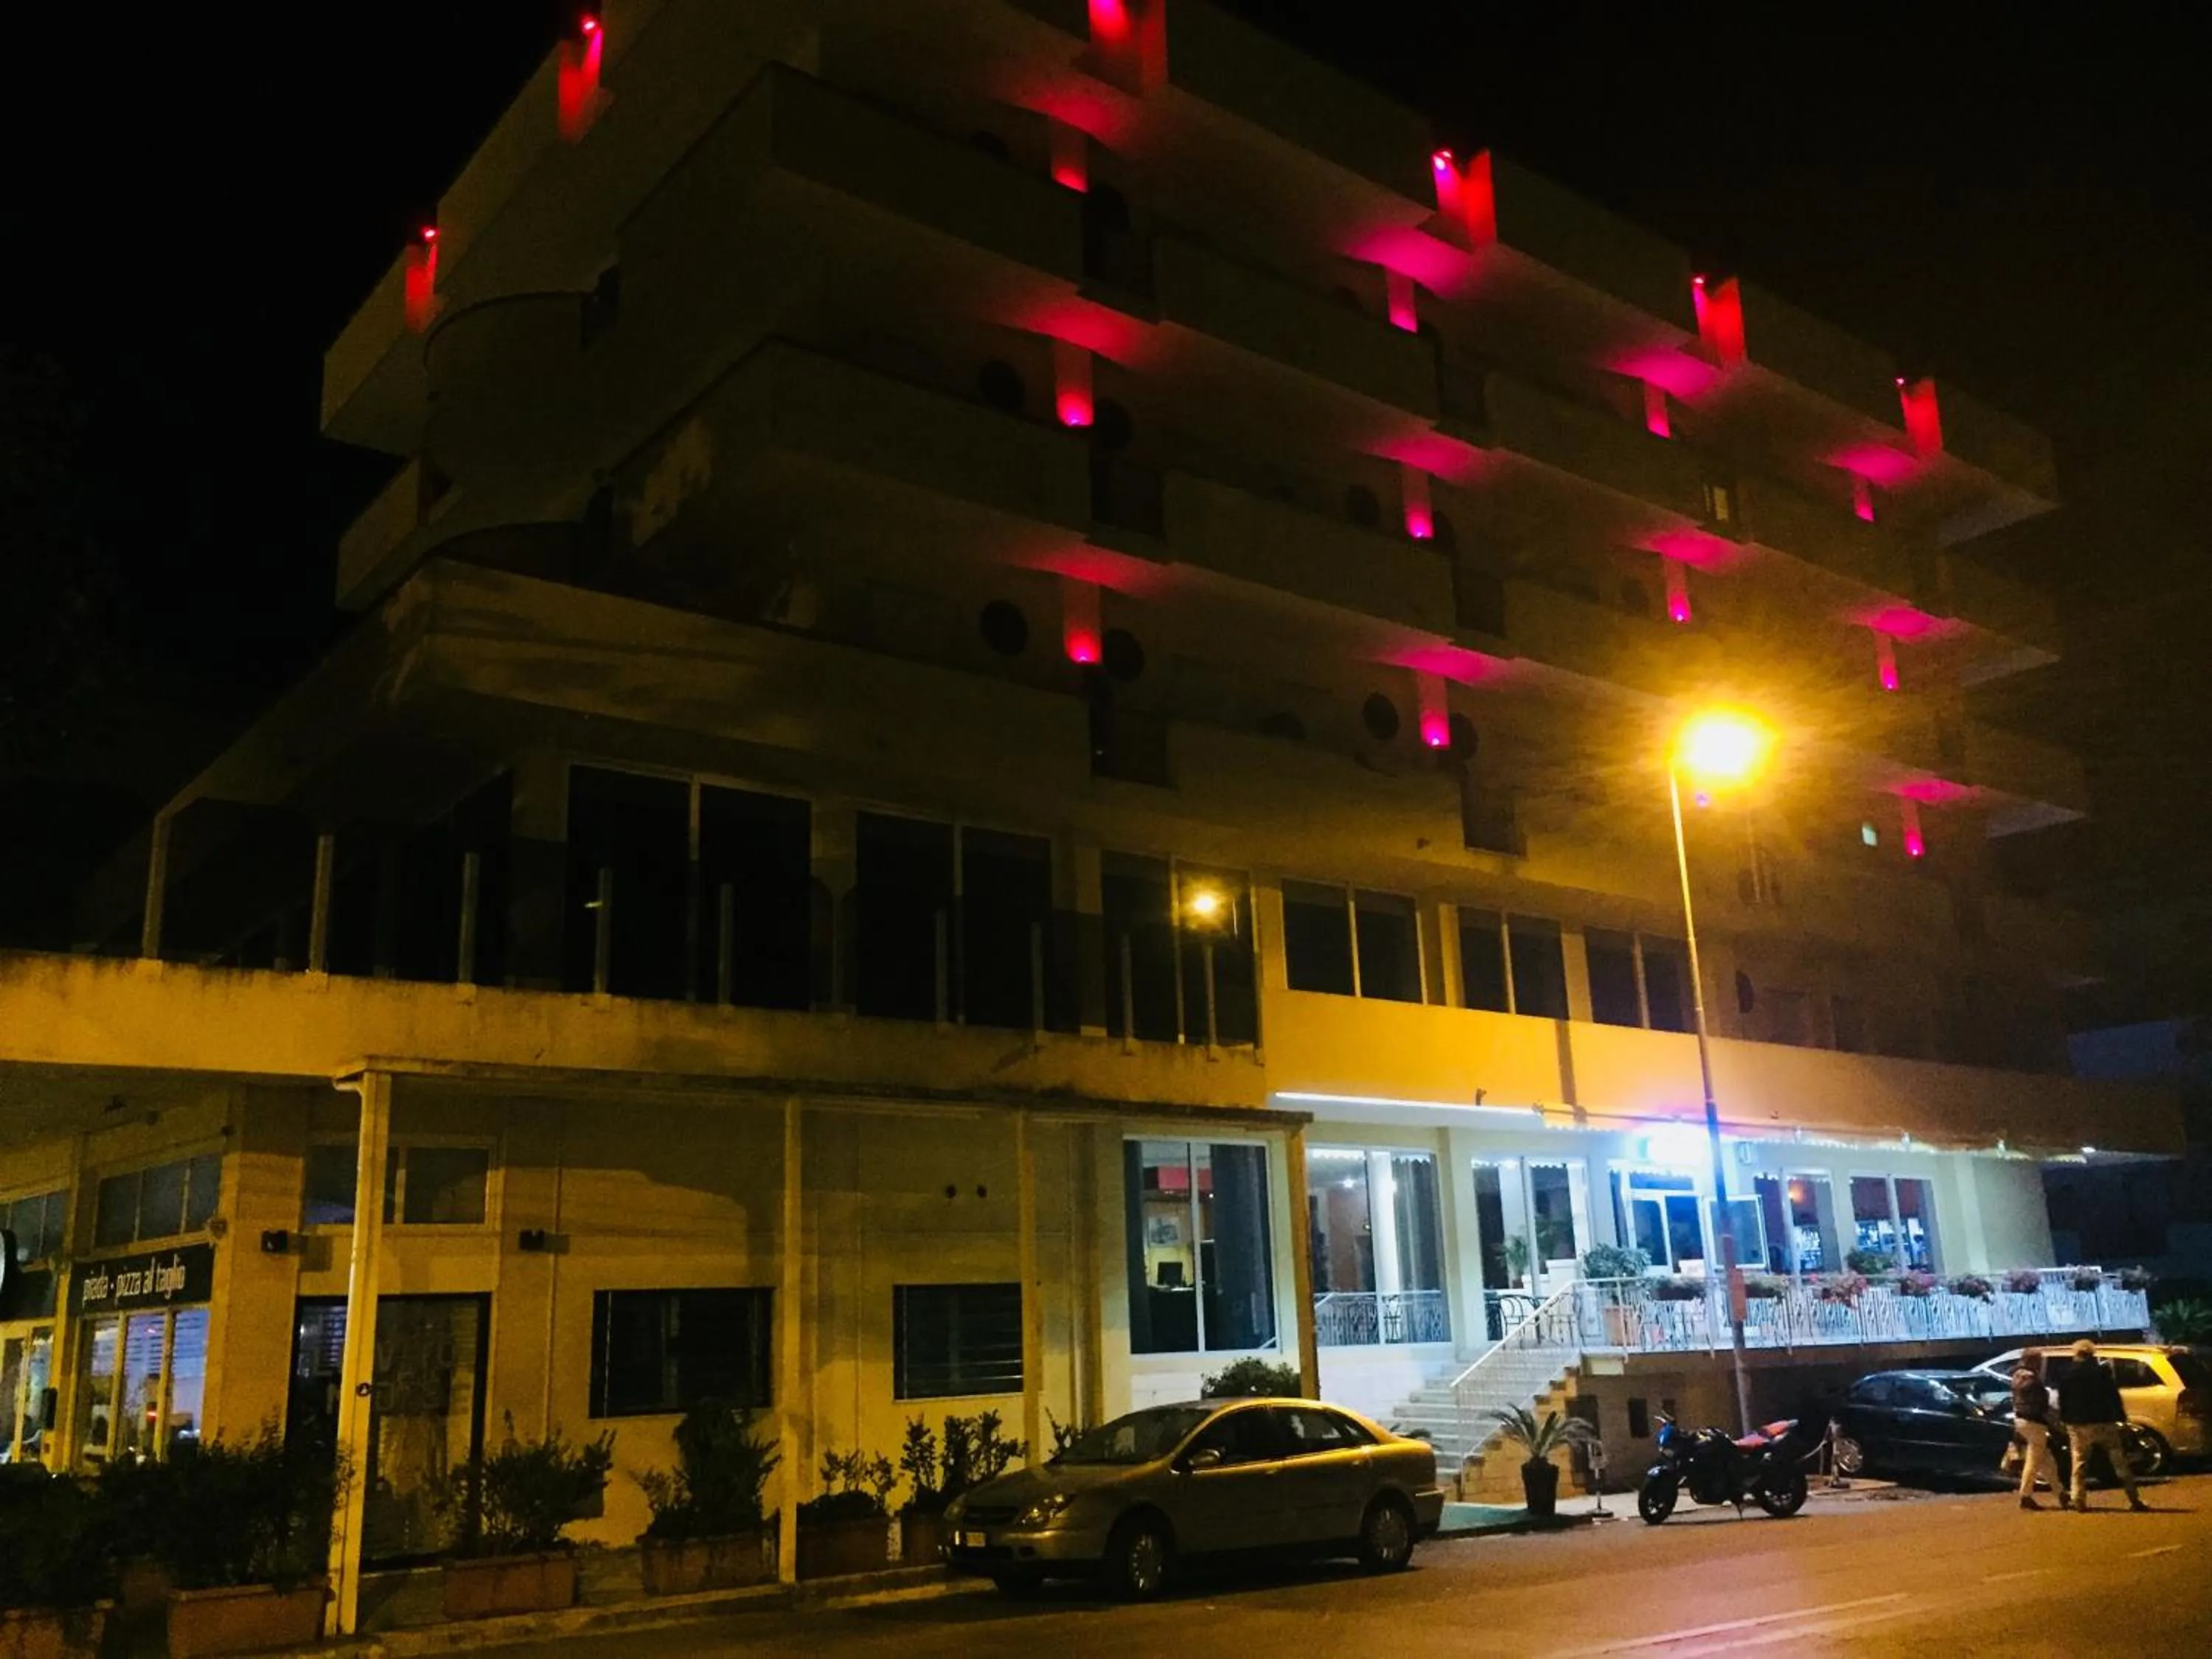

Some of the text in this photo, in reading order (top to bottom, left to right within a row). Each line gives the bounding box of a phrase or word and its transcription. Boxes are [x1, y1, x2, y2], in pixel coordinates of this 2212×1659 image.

[114, 1266, 142, 1307] pizza
[142, 1256, 155, 1293] al
[156, 1253, 187, 1299] taglio
